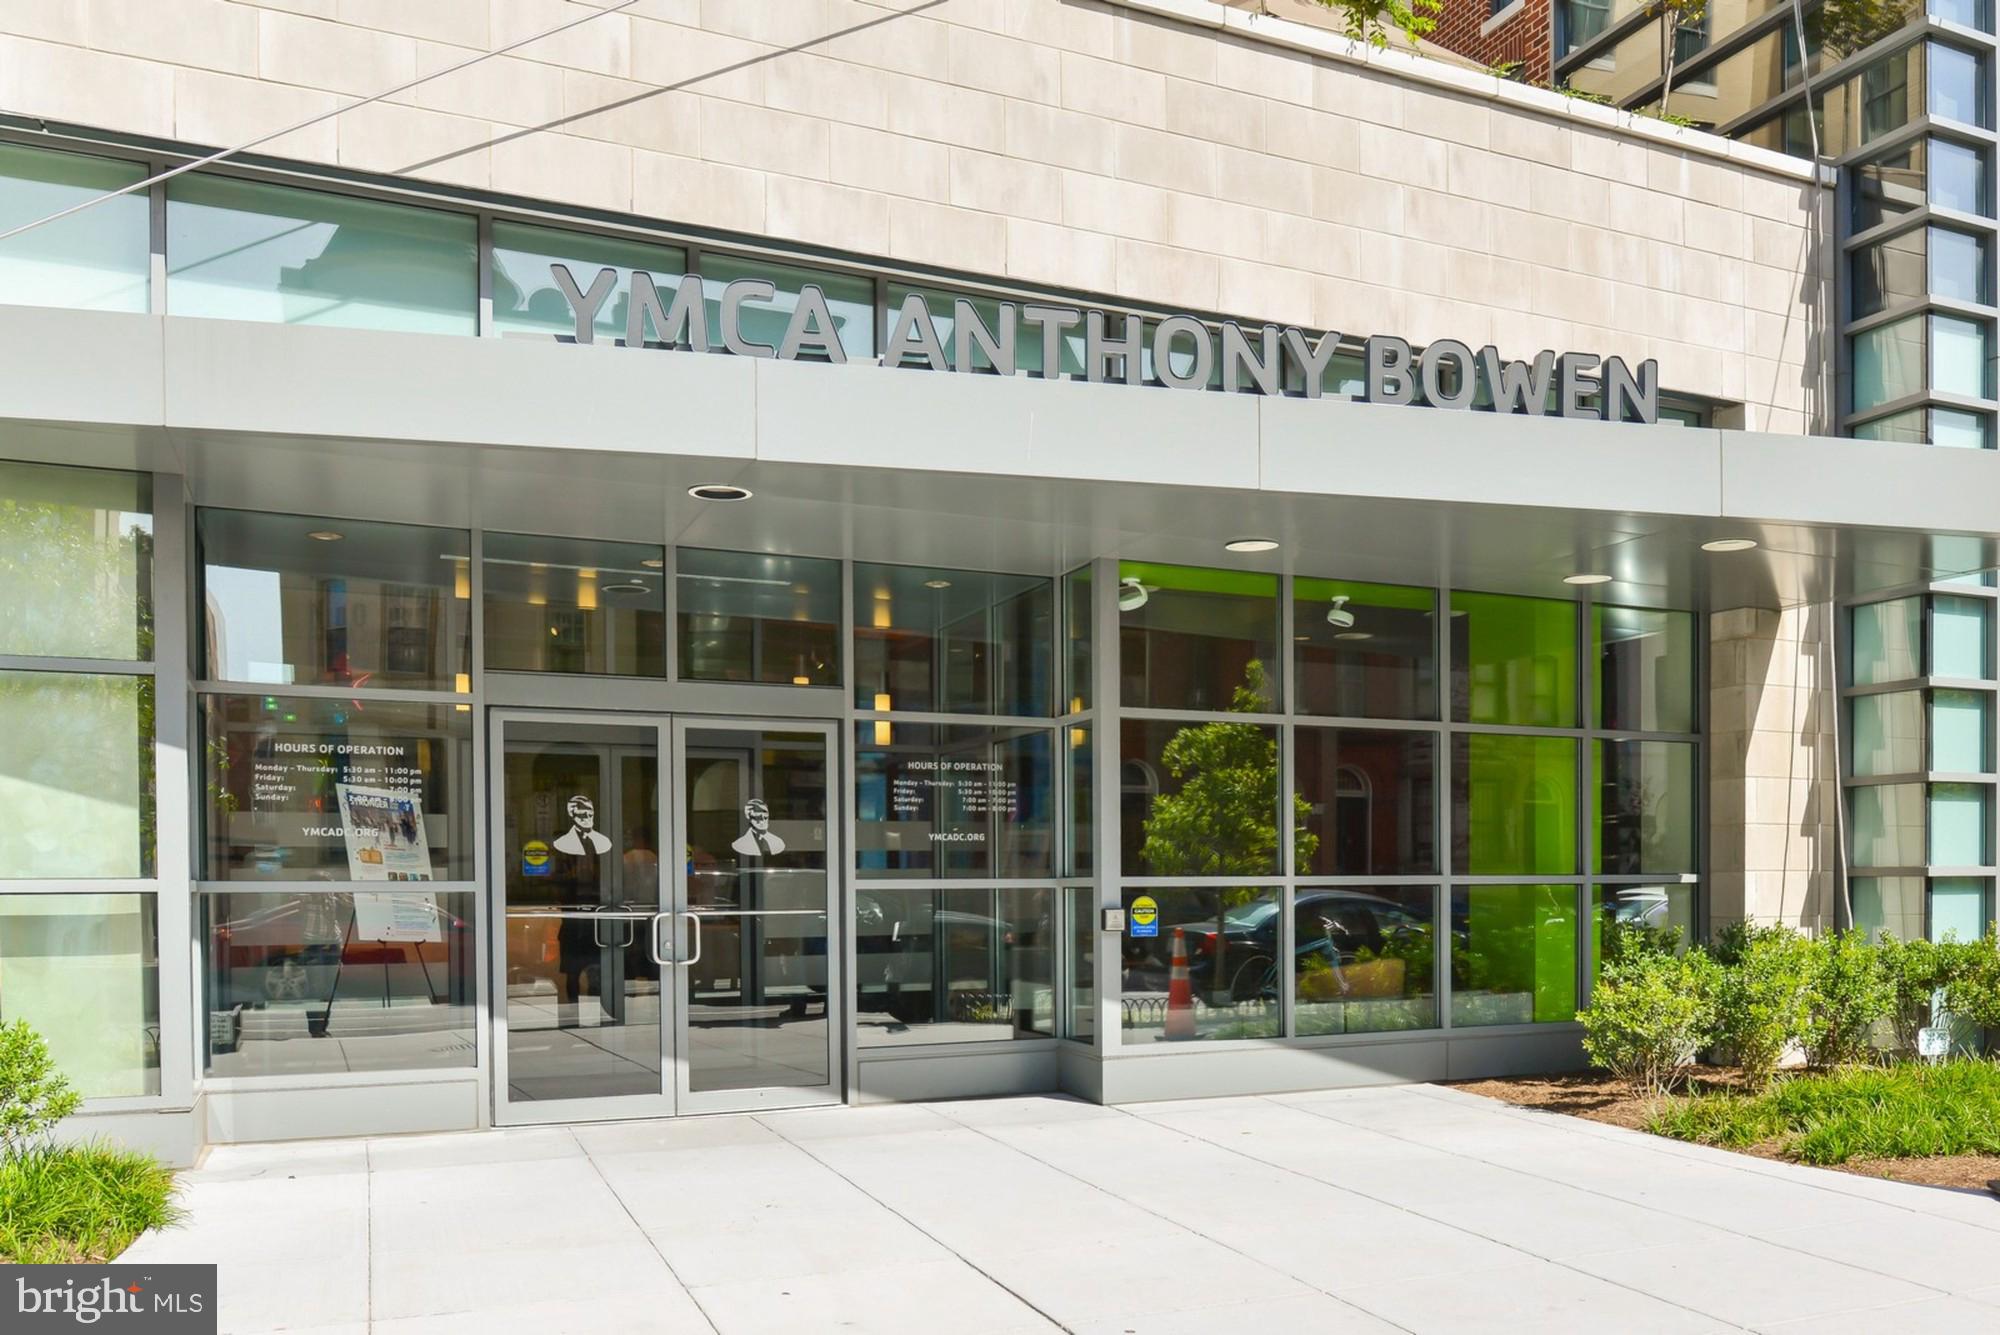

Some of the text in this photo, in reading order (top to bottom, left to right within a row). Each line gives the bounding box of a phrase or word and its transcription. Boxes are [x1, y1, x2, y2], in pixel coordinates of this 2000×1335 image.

[550, 263, 1658, 425] YMCA ANTHONY BOWEN
[274, 742, 404, 756] HOURS OF OPERATION
[254, 763, 288, 773] Monday
[296, 764, 338, 775] Thursday:
[343, 765, 362, 774] 5:30
[384, 767, 409, 775] 11:00
[907, 761, 1003, 771] HOURS OF OPERATION
[254, 773, 285, 783] Friday:
[343, 775, 362, 784] 5:30
[384, 776, 409, 784] 10:00
[409, 778, 422, 786] pm
[893, 779, 918, 788] Monday
[254, 783, 297, 793] Saturday:
[893, 787, 916, 795] Friday:
[254, 793, 289, 802] Sunday:
[893, 796, 925, 804] Saturday:
[893, 804, 919, 812] Sunday:
[928, 833, 986, 841] YMCADC.ORG
